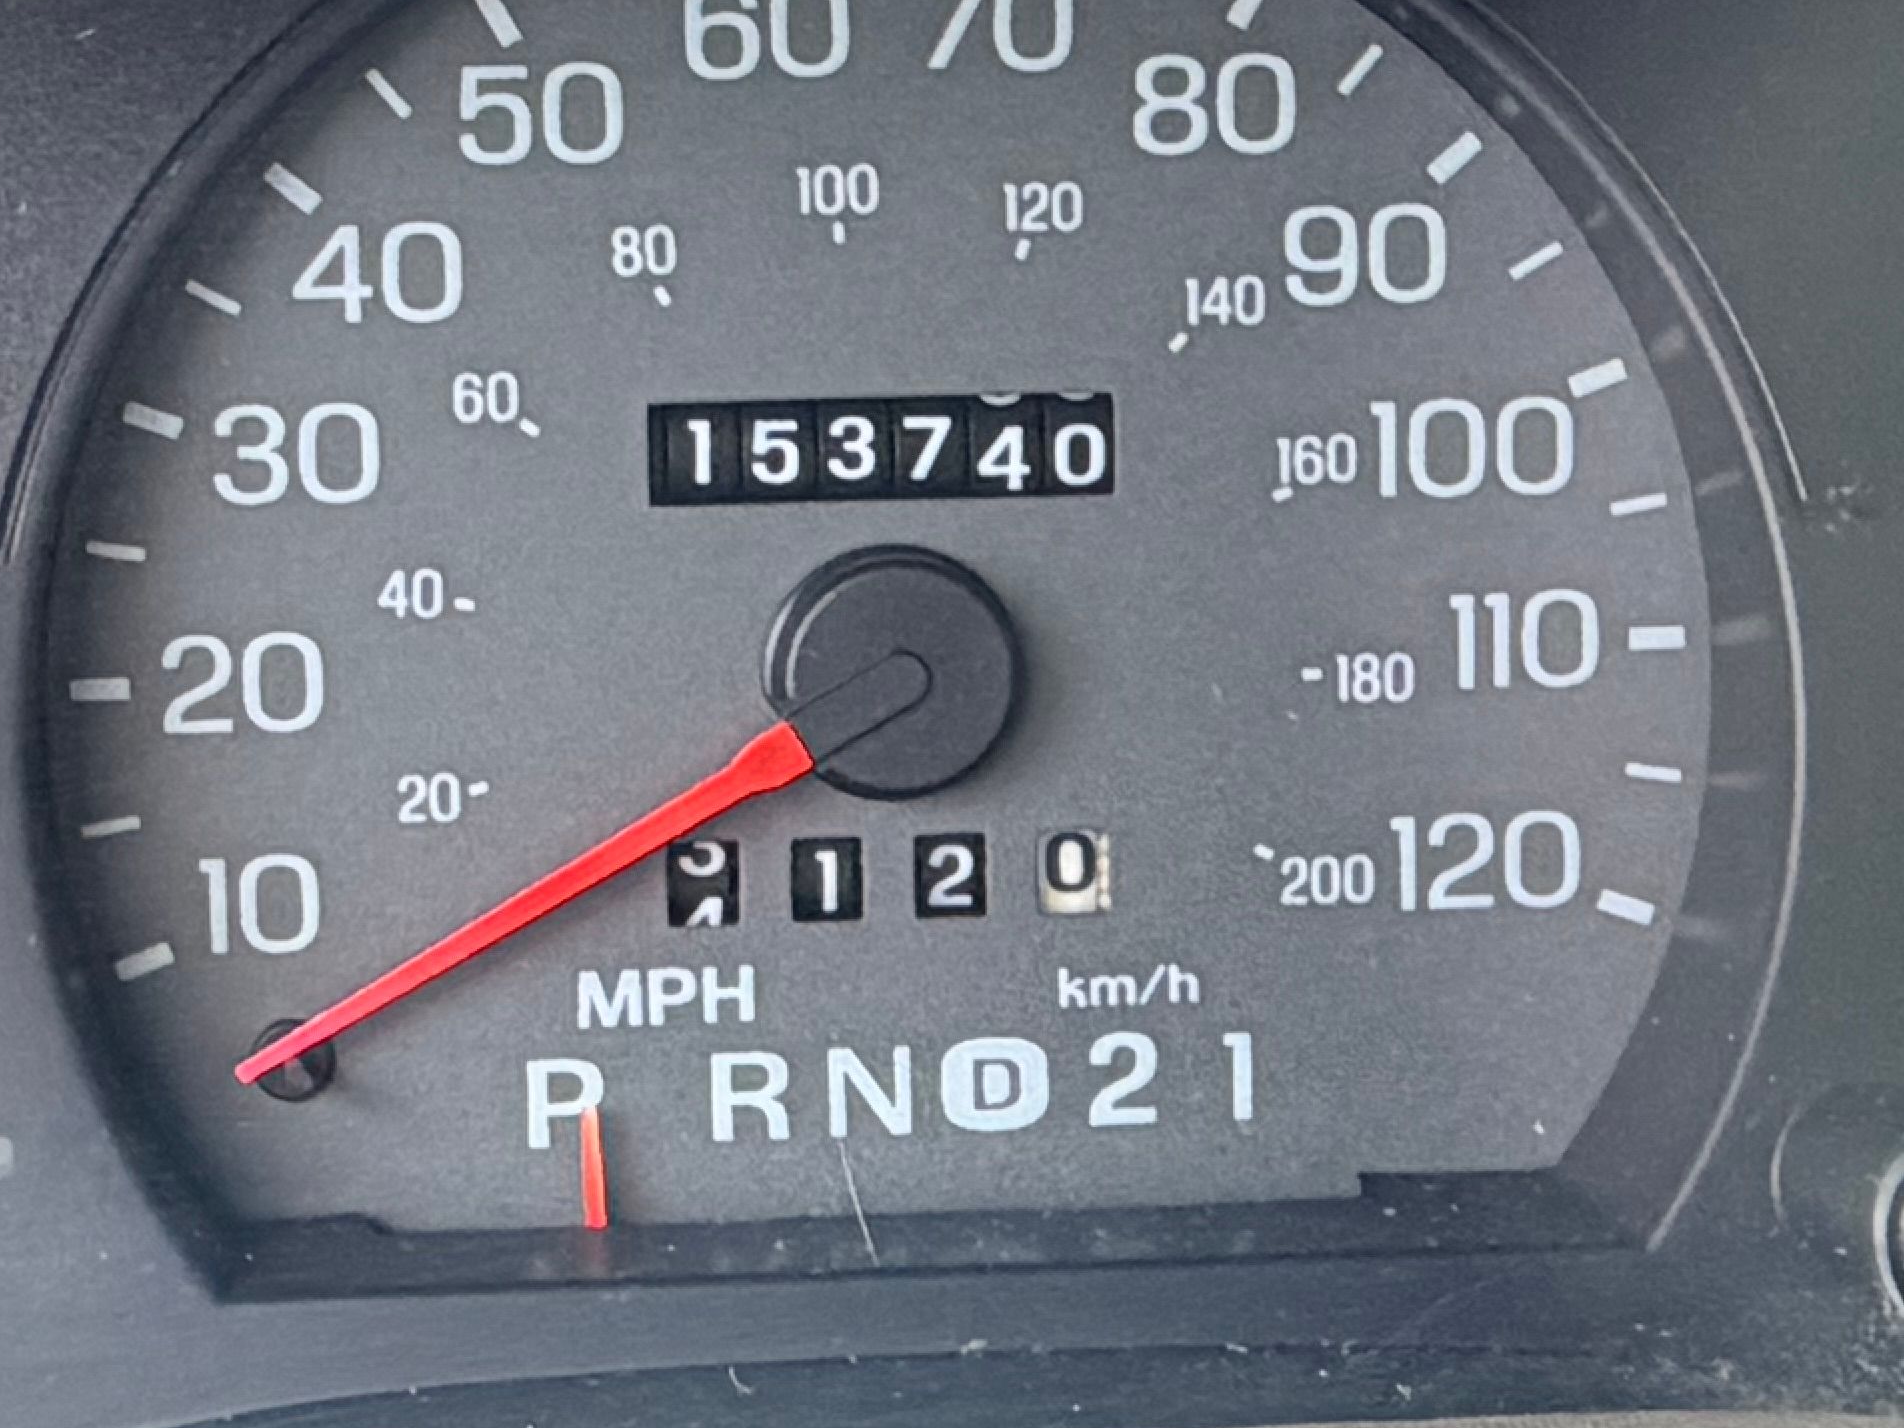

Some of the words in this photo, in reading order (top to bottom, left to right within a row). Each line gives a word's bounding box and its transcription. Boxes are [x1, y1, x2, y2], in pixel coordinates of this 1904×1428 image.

[459, 62, 624, 166] 50
[1133, 52, 1296, 156] 80
[796, 162, 880, 216] 100
[1003, 181, 1083, 233] 120
[292, 221, 463, 324] 40
[611, 224, 677, 278] 80
[1284, 203, 1447, 306] 90
[1185, 274, 1266, 326] 140
[452, 371, 519, 424] 60
[213, 402, 380, 506] 30
[686, 416, 1107, 490] 153740
[1276, 434, 1357, 484] 160
[1370, 395, 1574, 498] 100
[377, 567, 444, 619] 40
[1449, 588, 1600, 690] 110
[162, 631, 324, 734] 20
[1336, 652, 1415, 704] 180
[397, 772, 461, 824] 20
[1280, 853, 1375, 906] 200
[1389, 810, 1581, 911] 120
[199, 853, 320, 954] 10
[576, 964, 755, 1030] MPH
[1057, 963, 1200, 1009] km/h
[526, 1059, 604, 1149] P
[710, 1050, 790, 1142] R
[827, 1046, 912, 1136] N
[1088, 1031, 1158, 1127] 2
[1222, 1032, 1253, 1121] 1
